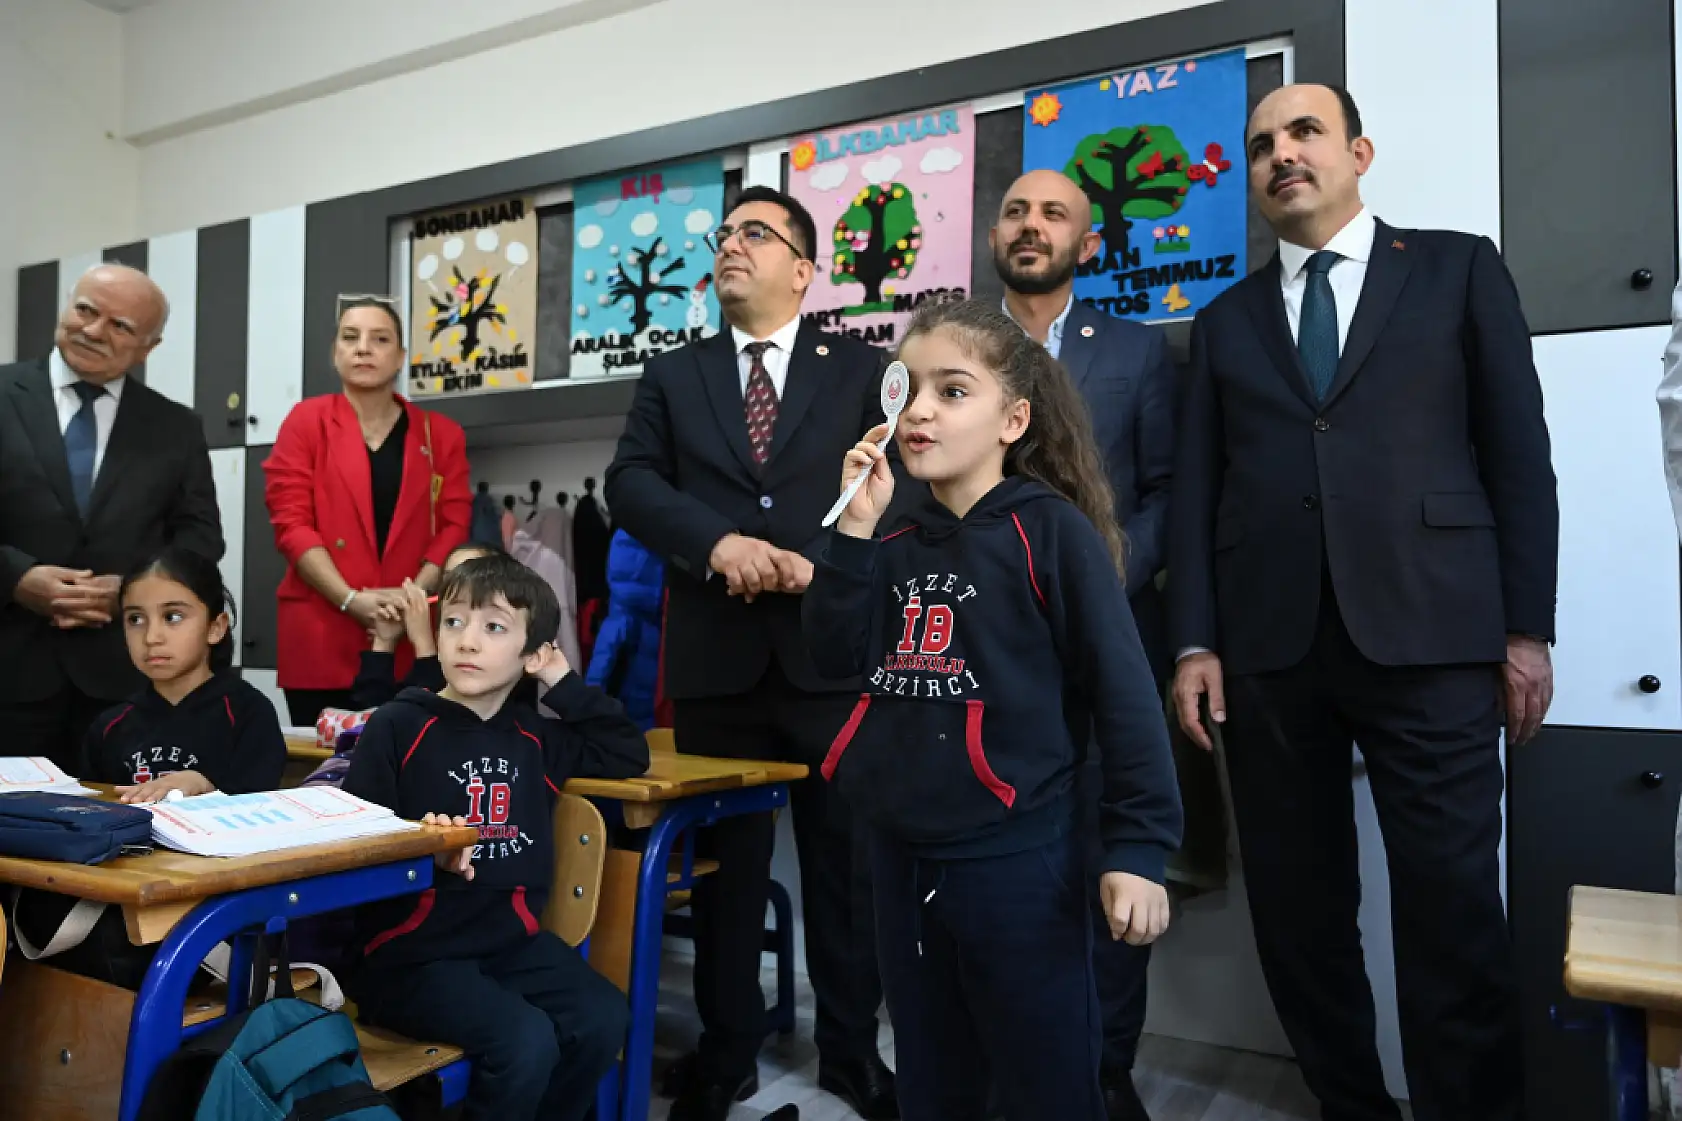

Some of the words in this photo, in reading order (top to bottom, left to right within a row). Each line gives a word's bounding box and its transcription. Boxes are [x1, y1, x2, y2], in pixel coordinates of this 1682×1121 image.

[1112, 64, 1178, 99] YAZ
[815, 109, 960, 162] İLKBAHAR
[621, 173, 665, 204] KIŞ
[415, 200, 524, 239] SONBAHAR
[1112, 254, 1235, 292] TEMMUZ
[573, 333, 635, 353] ARALIK
[896, 596, 954, 654] İB
[465, 776, 511, 825] İB
